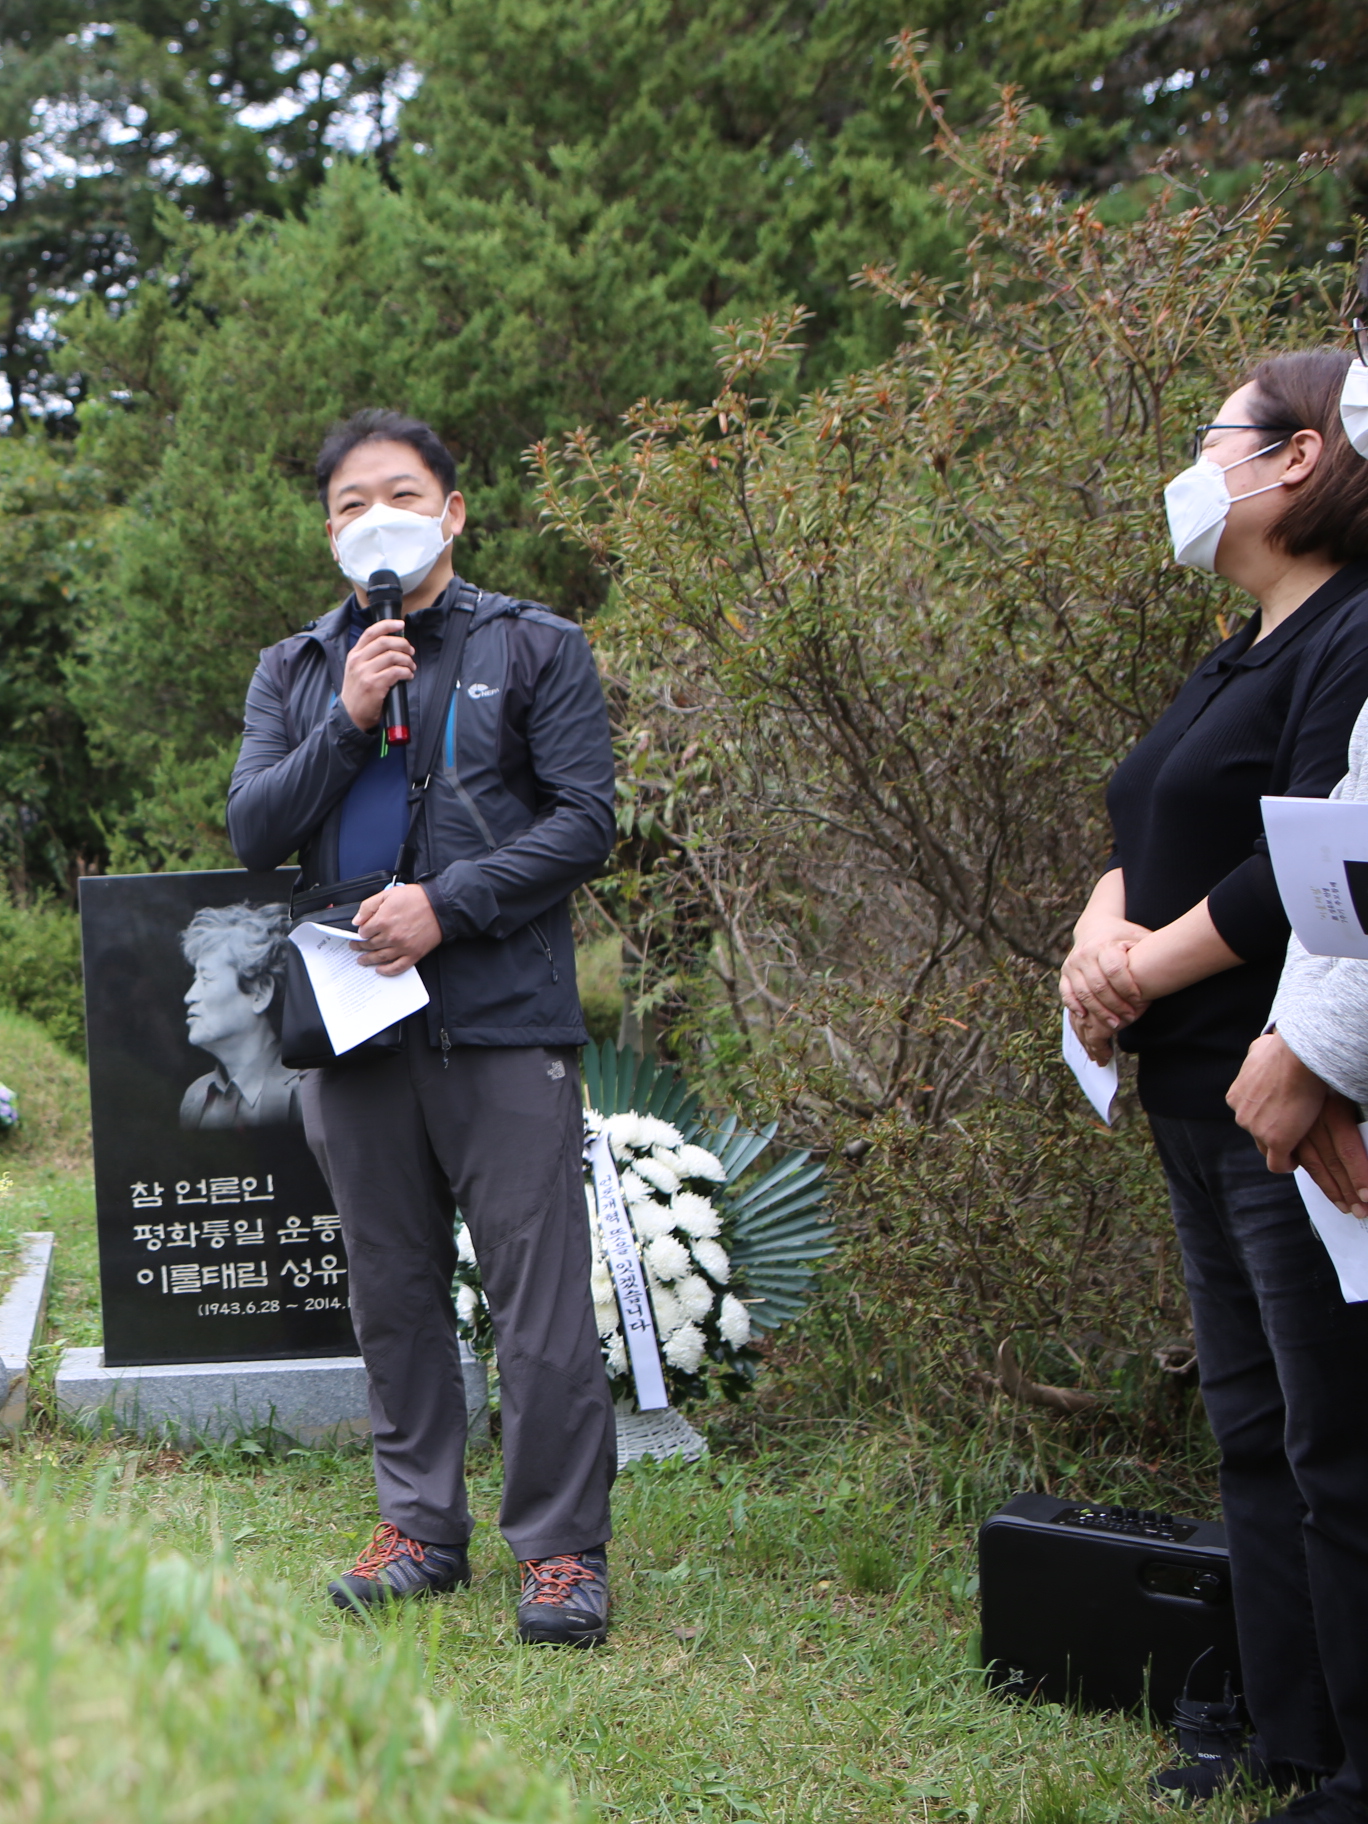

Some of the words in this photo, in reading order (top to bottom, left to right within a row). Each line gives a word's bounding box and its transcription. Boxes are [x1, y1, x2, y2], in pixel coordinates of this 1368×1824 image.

[129, 1181, 165, 1208] 참
[175, 1174, 275, 1205] 언론인
[133, 1218, 266, 1251] 평화통일
[136, 1261, 269, 1294] 이룰태림
